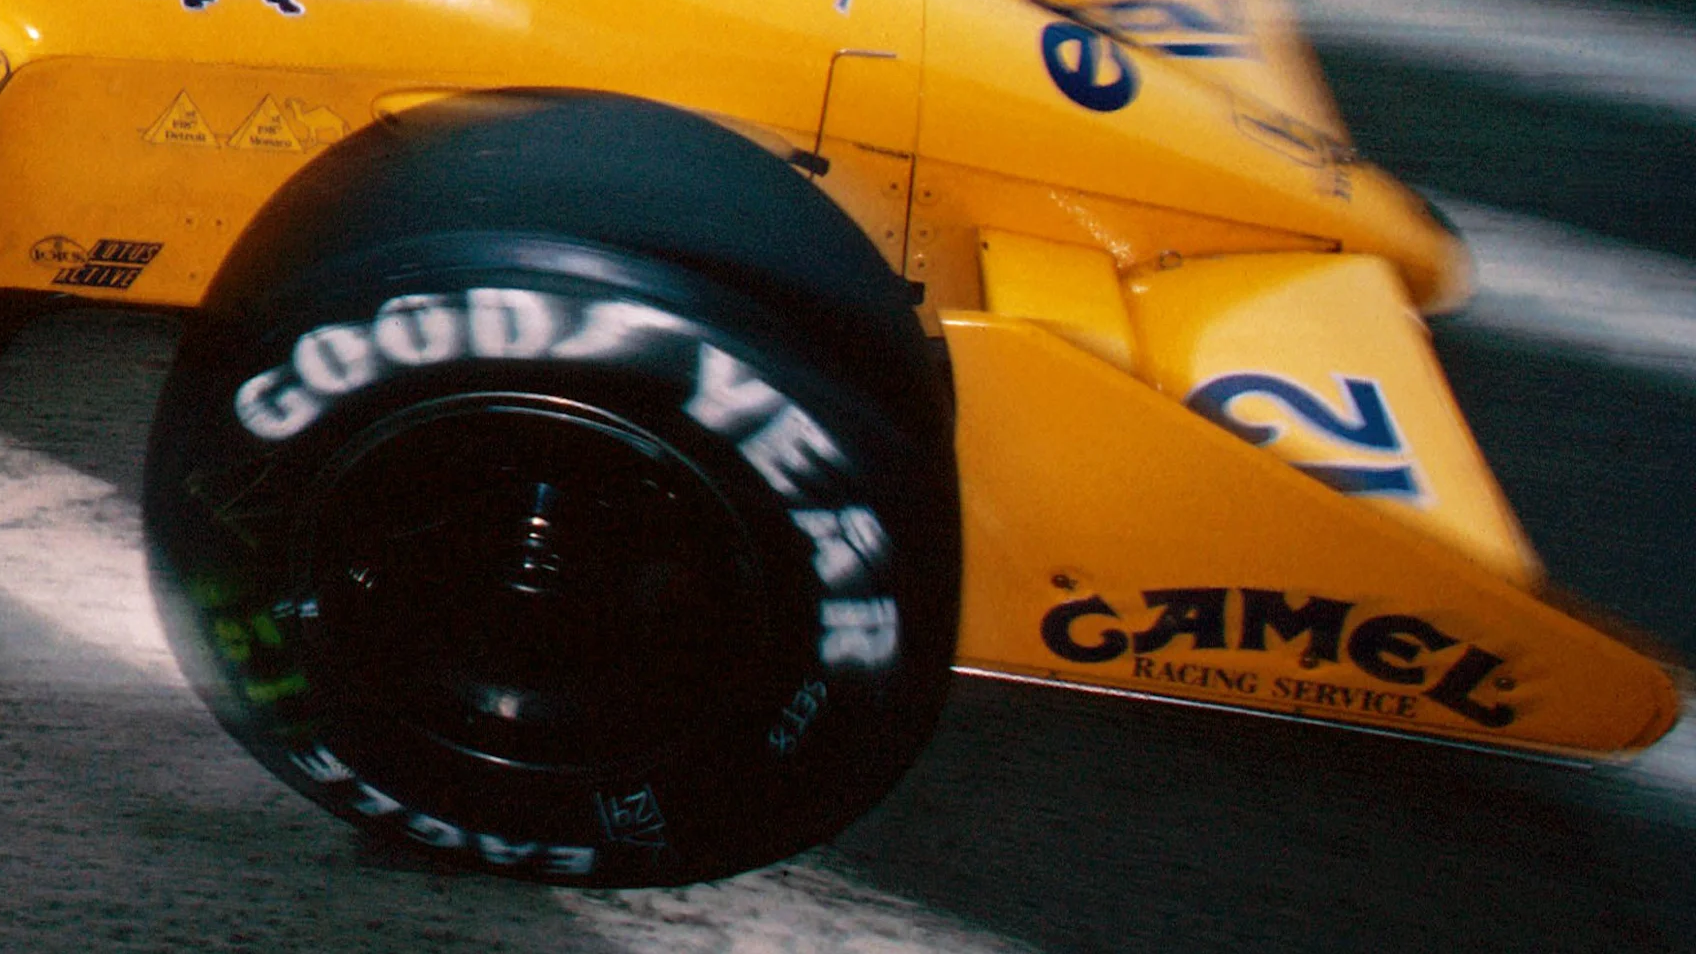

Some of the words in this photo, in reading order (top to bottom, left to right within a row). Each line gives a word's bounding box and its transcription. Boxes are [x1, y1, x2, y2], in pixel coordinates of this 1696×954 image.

[88, 241, 160, 264] LOTUS
[53, 265, 140, 287] ACTIVE
[1039, 587, 1521, 729] CAMEL
[1131, 656, 1260, 696] RACING
[1271, 676, 1420, 721] SERVICE
